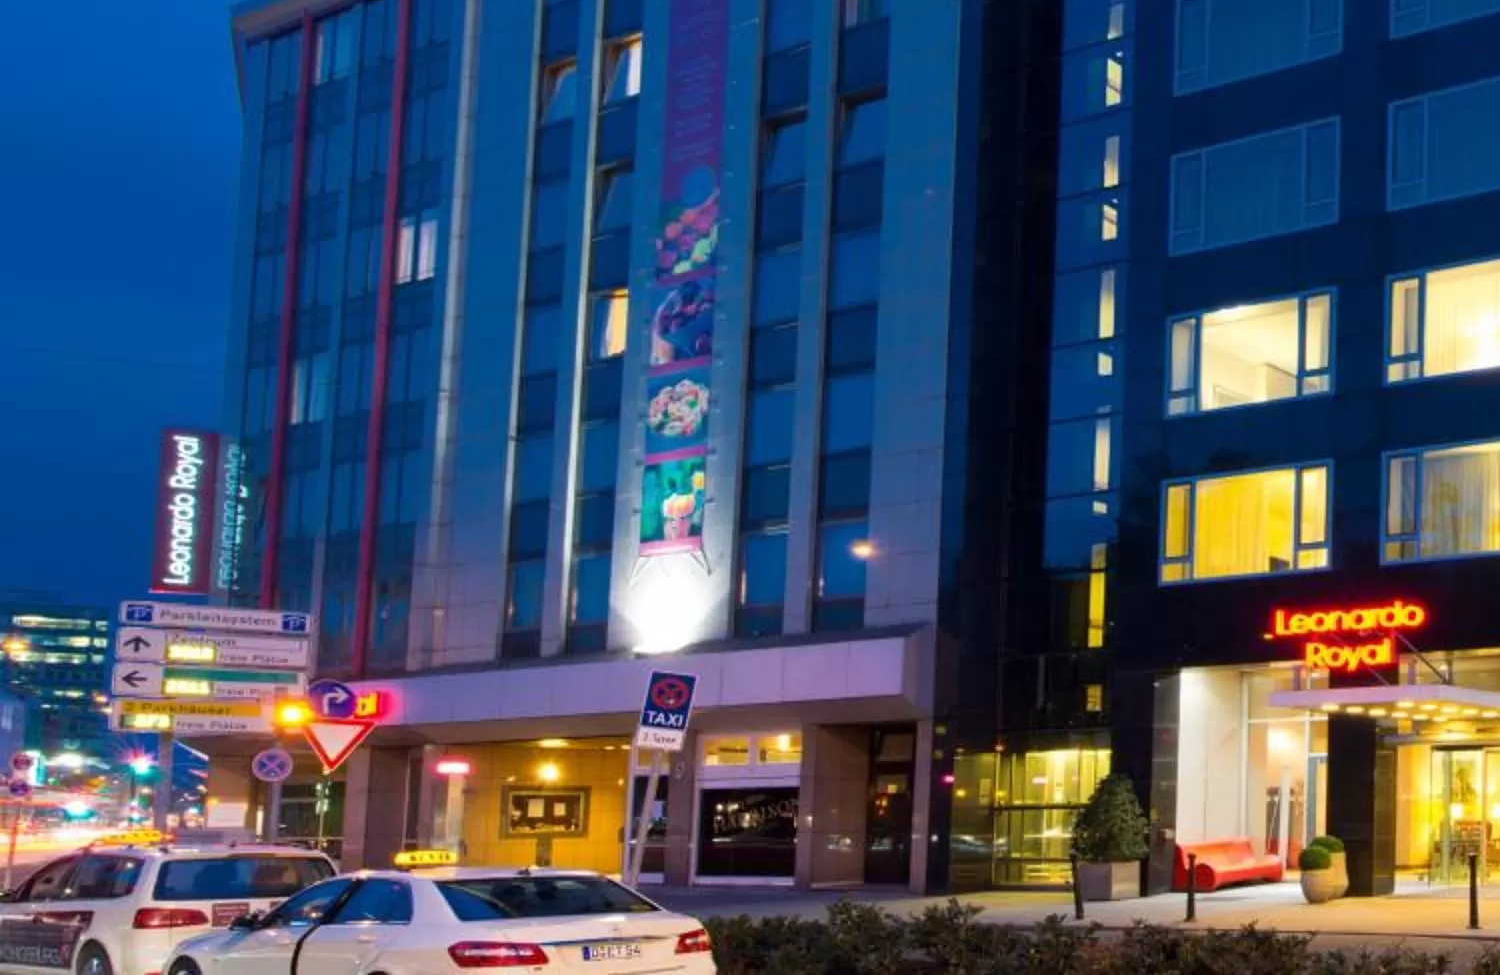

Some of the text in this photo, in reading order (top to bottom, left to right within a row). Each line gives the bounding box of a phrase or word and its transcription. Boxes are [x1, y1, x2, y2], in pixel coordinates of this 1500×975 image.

[162, 434, 204, 585] Leonardo Royal
[160, 607, 277, 627] Parkleitsystem
[1275, 600, 1425, 636] Leonardo
[1305, 638, 1392, 672] Royal
[646, 710, 684, 727] TAXI
